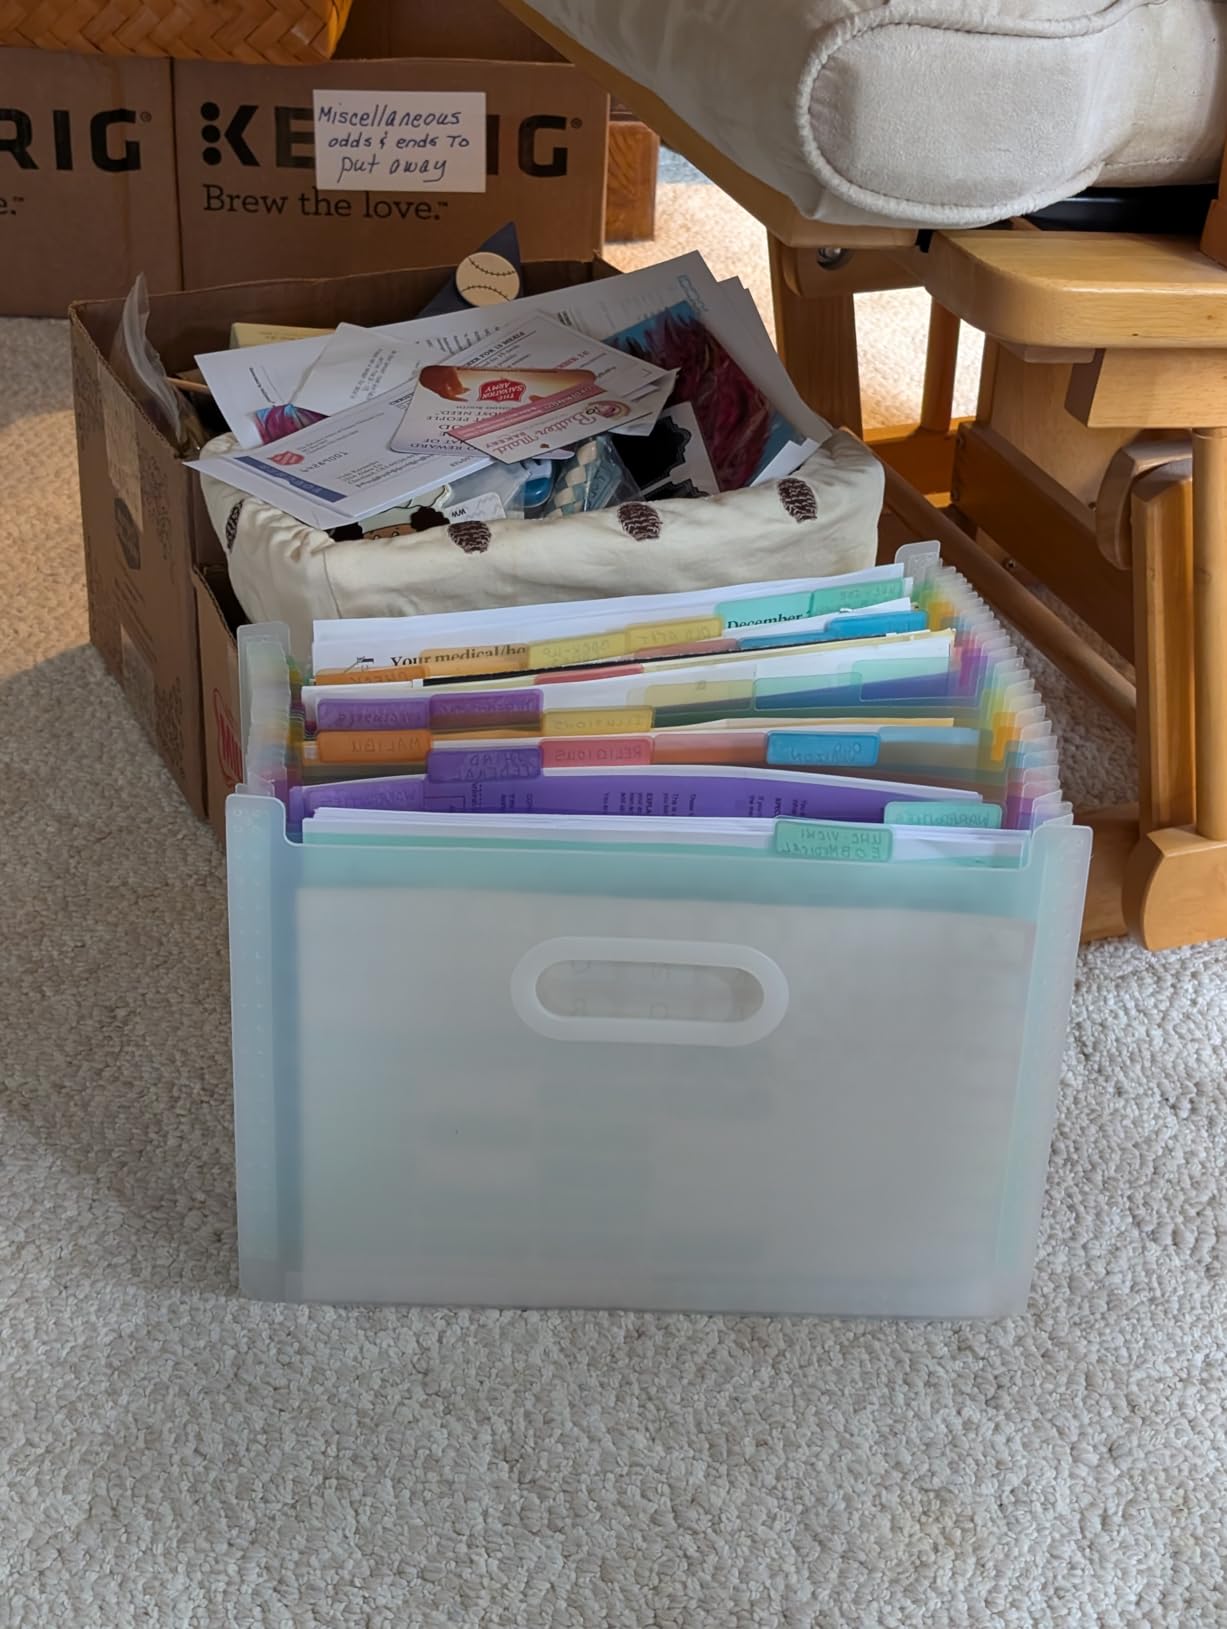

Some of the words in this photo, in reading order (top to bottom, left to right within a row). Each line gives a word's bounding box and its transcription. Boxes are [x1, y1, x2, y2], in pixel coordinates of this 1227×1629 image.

[318, 102, 462, 128] Miscellaneous
[200, 101, 569, 178] KEIG
[328, 132, 372, 148] odds
[395, 133, 439, 149] ends
[337, 154, 380, 183] put
[202, 184, 288, 214] Brew
[298, 186, 352, 217] the
